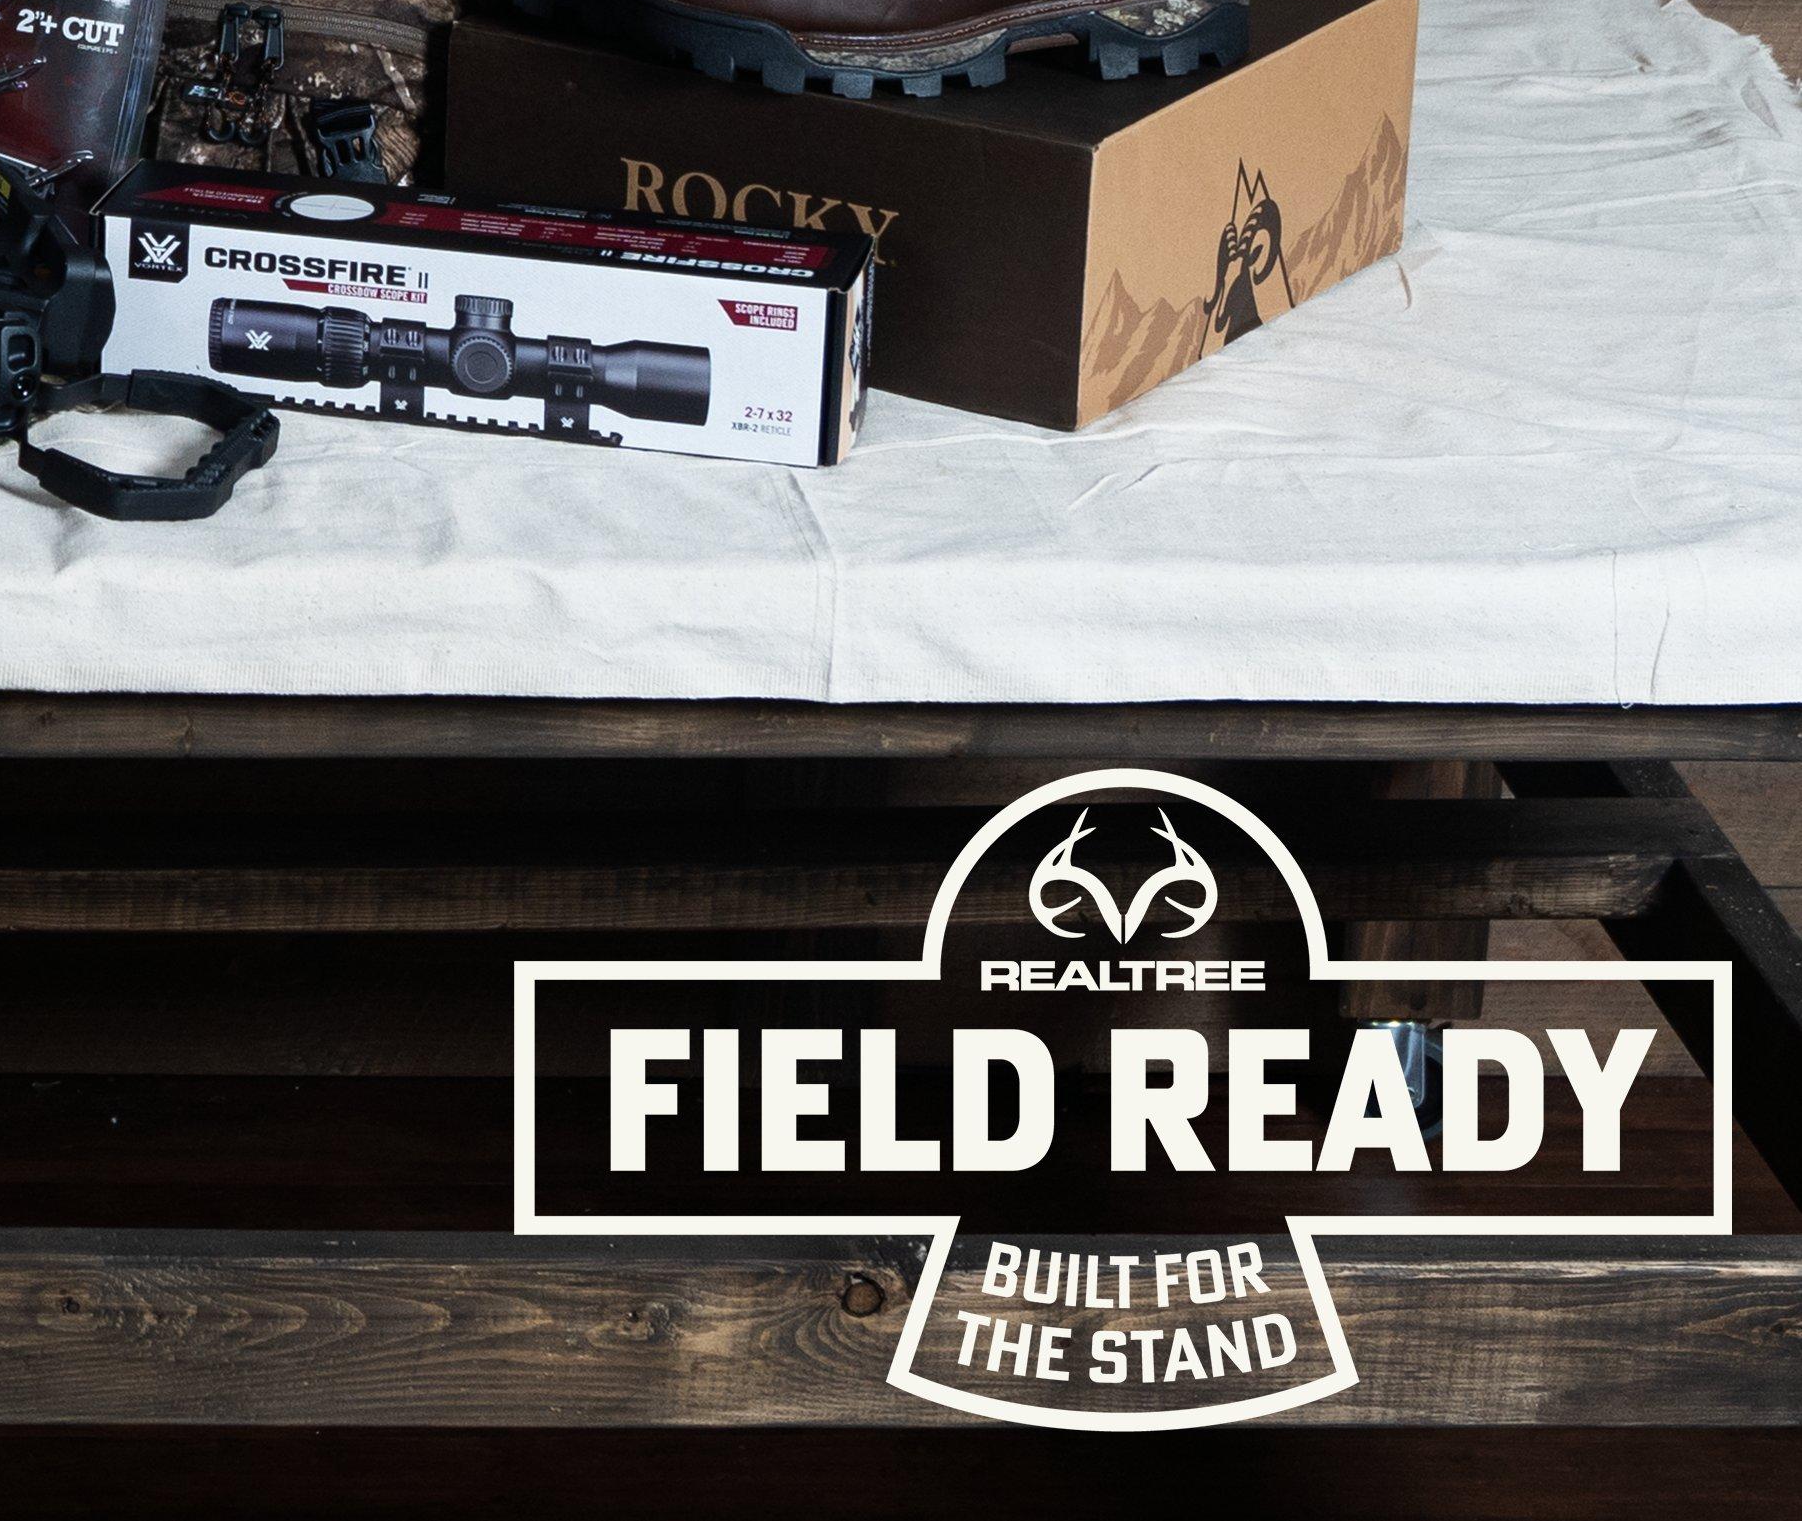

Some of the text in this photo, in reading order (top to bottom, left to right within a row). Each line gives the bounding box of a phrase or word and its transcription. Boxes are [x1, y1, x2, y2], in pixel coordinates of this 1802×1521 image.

[62, 16, 126, 48] CUT
[620, 157, 901, 267] ROCKY
[134, 262, 184, 273] VORTEX
[204, 246, 428, 289] CROSSFIRE II
[620, 251, 815, 279] CROSSFIRE
[327, 283, 427, 304] CROSSBOW SCOPE KIT
[734, 302, 796, 319] SCOPE RINGS
[749, 315, 795, 330] INCLUDED
[744, 406, 765, 420] 2-7
[776, 410, 793, 423] 32
[760, 424, 792, 437] RETICLE
